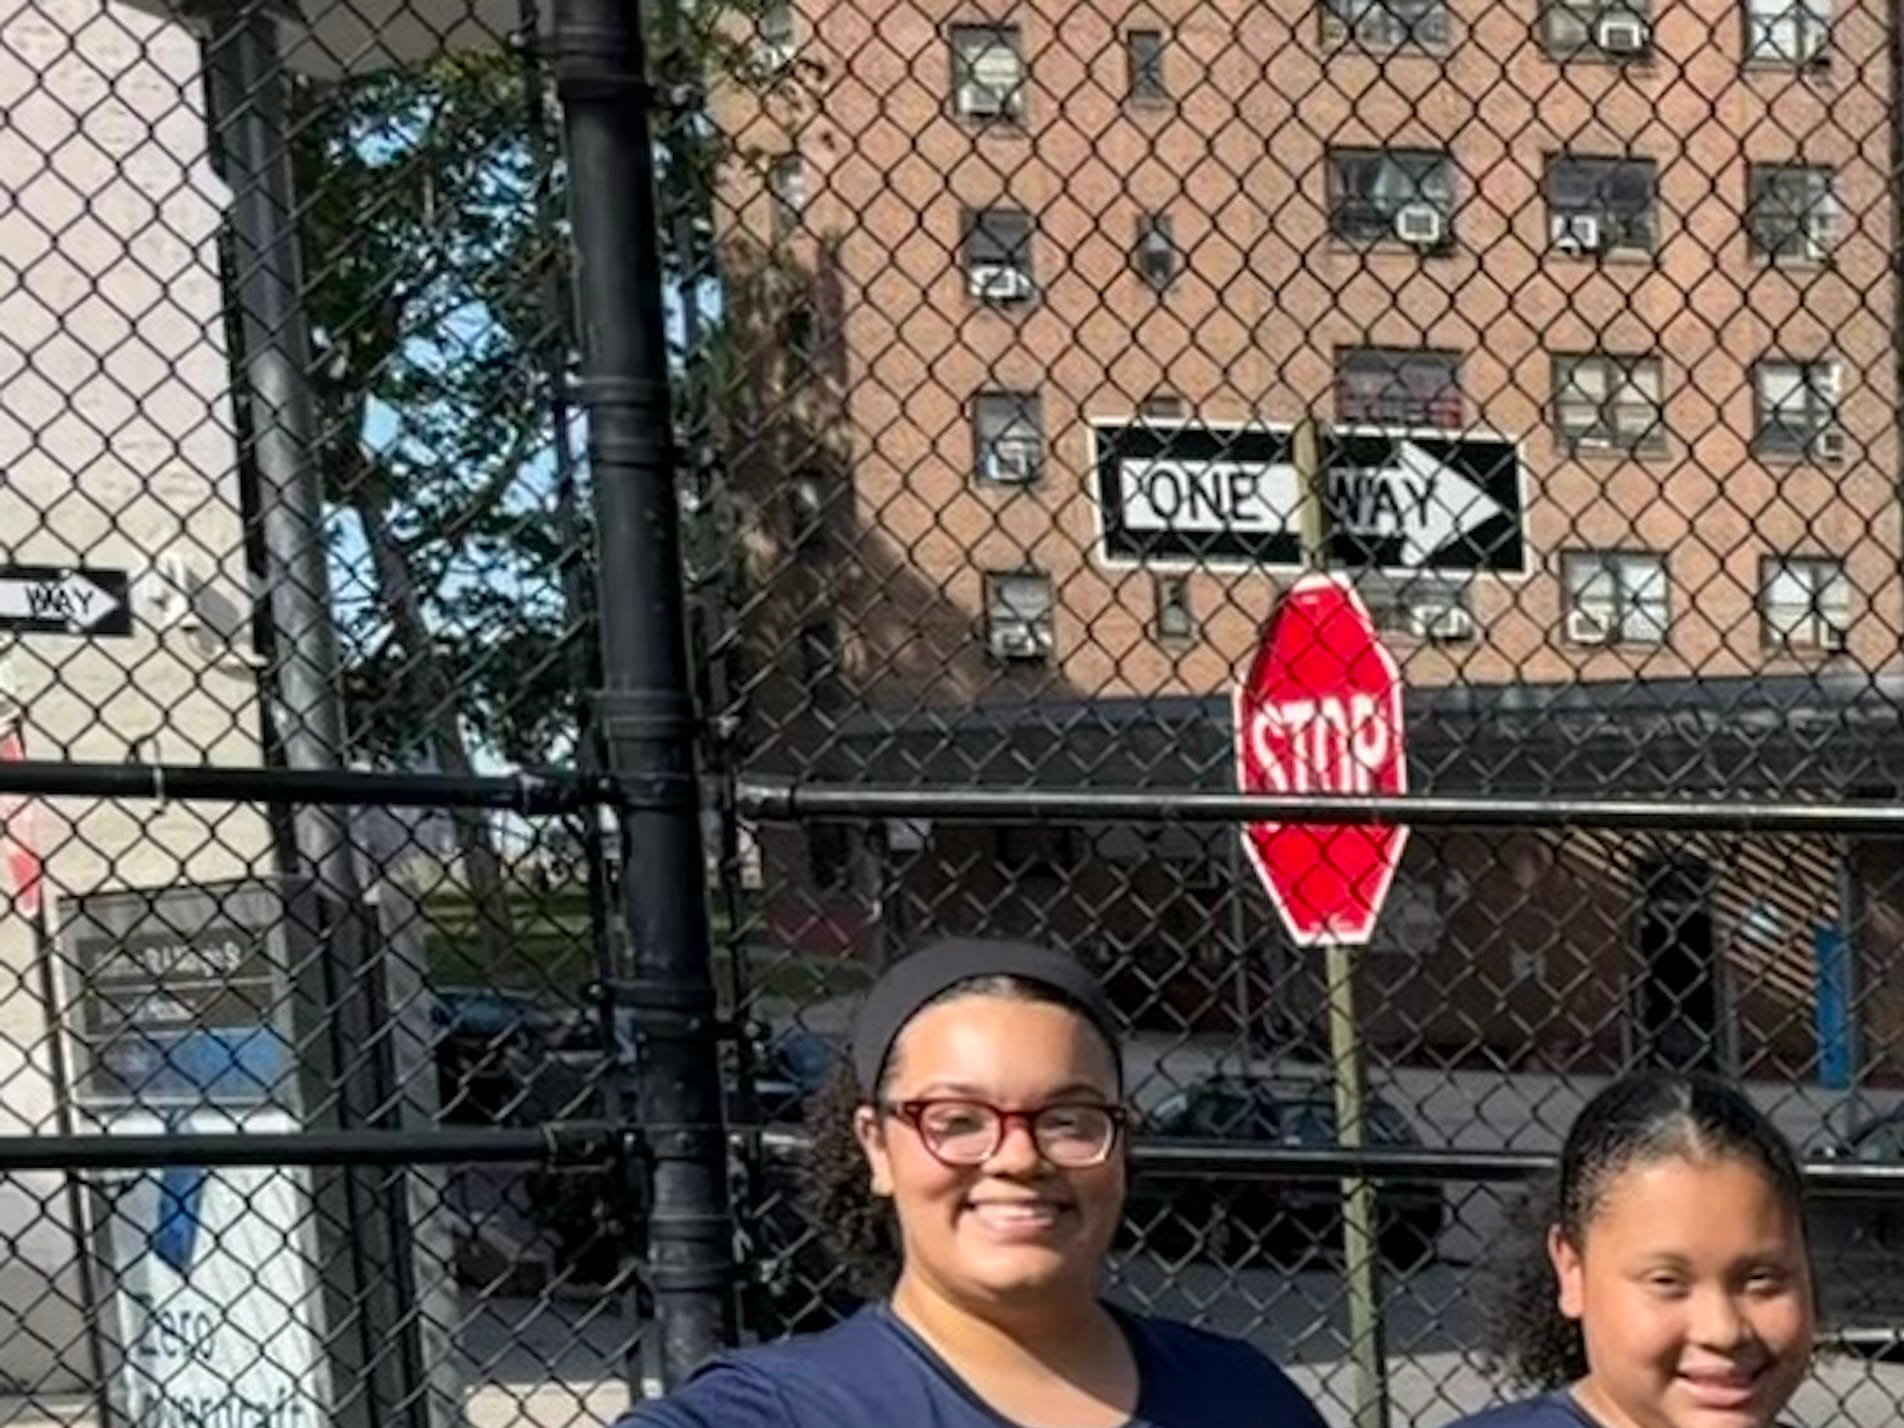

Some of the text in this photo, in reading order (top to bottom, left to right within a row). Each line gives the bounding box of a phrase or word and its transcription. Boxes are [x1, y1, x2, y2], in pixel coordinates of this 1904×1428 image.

[1150, 467, 1438, 528] ONE WAY
[1252, 692, 1388, 832] STOP
